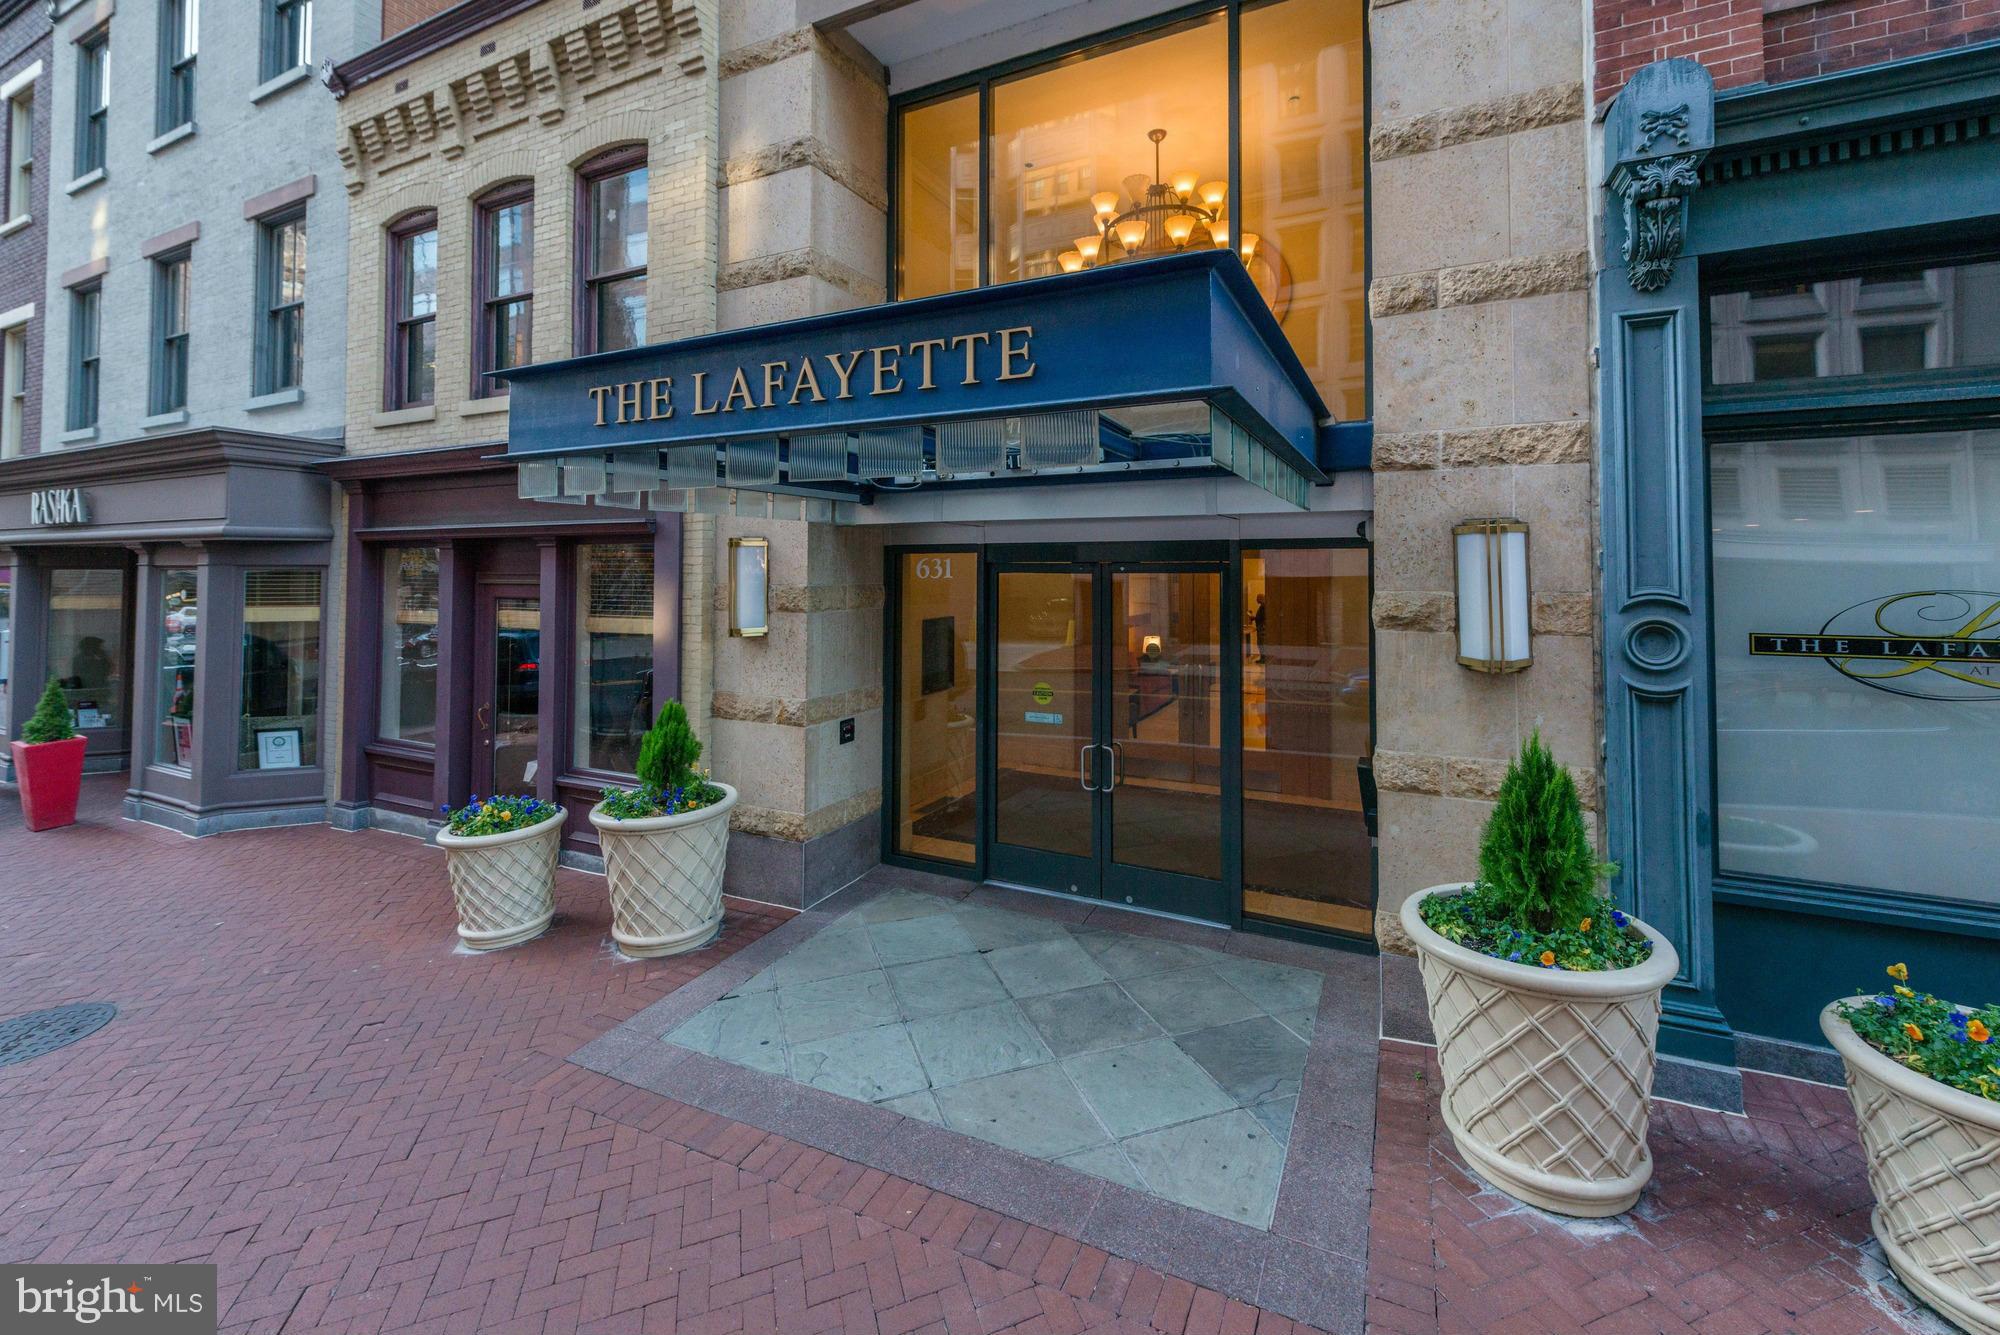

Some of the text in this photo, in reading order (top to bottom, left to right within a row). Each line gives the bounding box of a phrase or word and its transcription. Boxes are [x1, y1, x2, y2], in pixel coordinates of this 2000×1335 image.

[588, 326, 1036, 426] THE LAFAYETTE
[31, 488, 81, 525] RASIKA
[916, 558, 953, 579] 631
[1770, 637, 2000, 658] THE LAFA
[1970, 666, 1995, 676] AT
